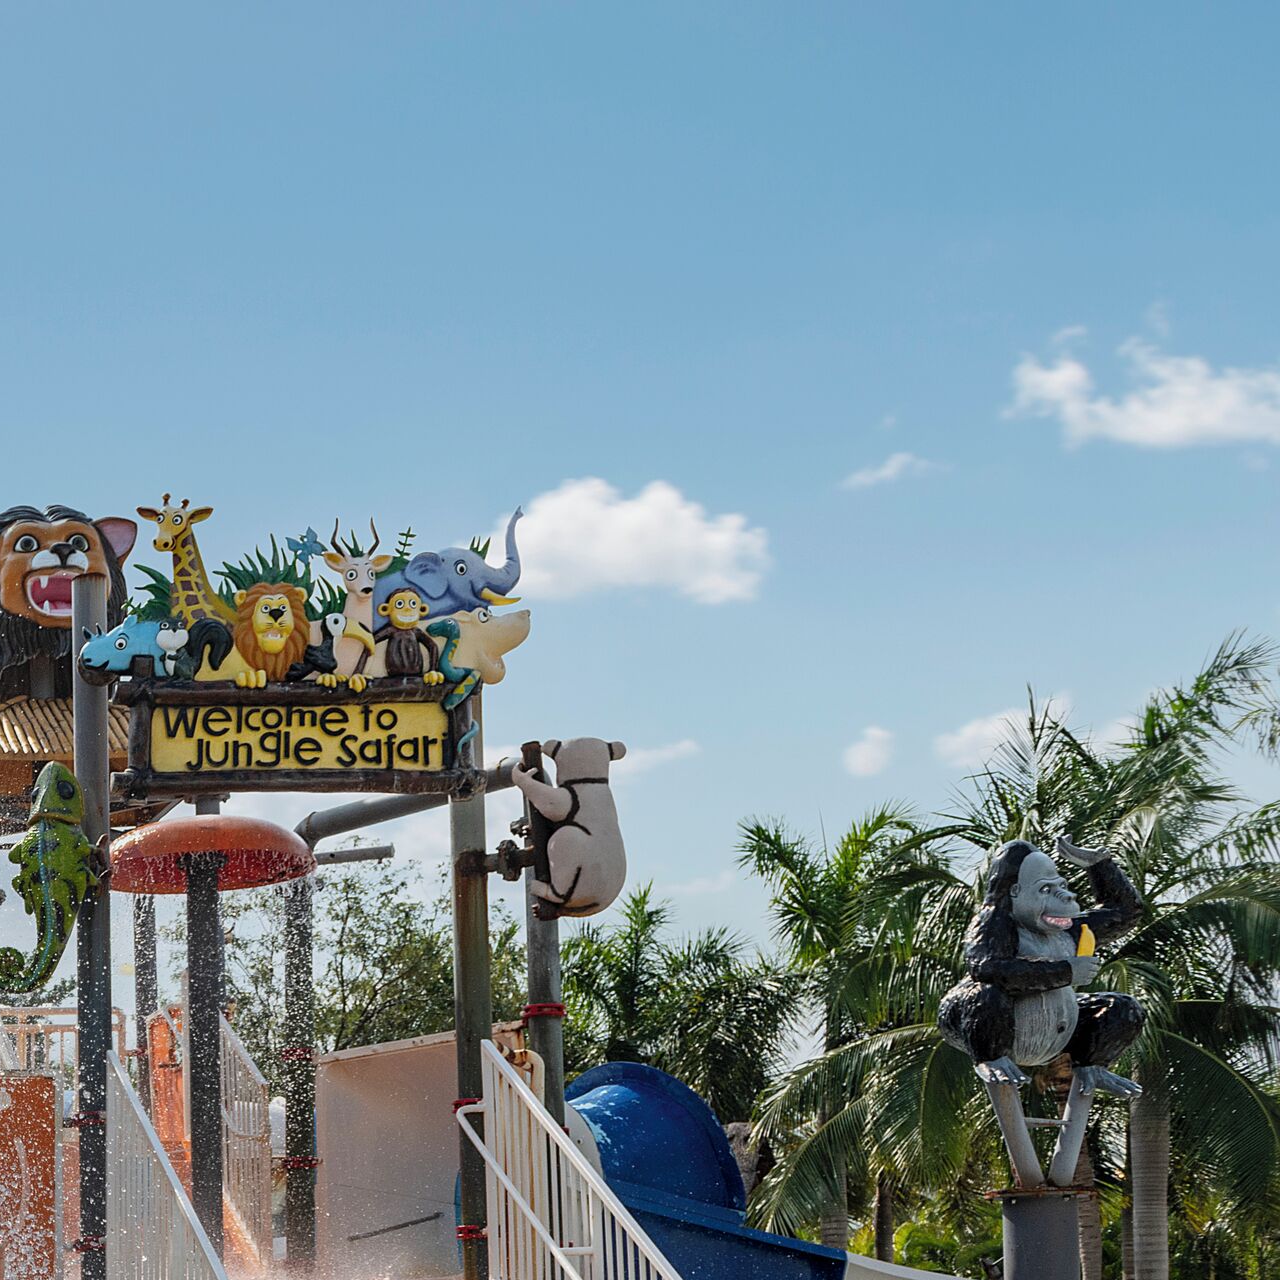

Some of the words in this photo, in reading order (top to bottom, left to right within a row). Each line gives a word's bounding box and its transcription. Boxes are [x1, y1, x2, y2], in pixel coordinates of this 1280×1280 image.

[161, 704, 349, 738] Welcome
[361, 704, 399, 732] to
[186, 729, 323, 770] Jungle
[336, 731, 449, 770] Safari
